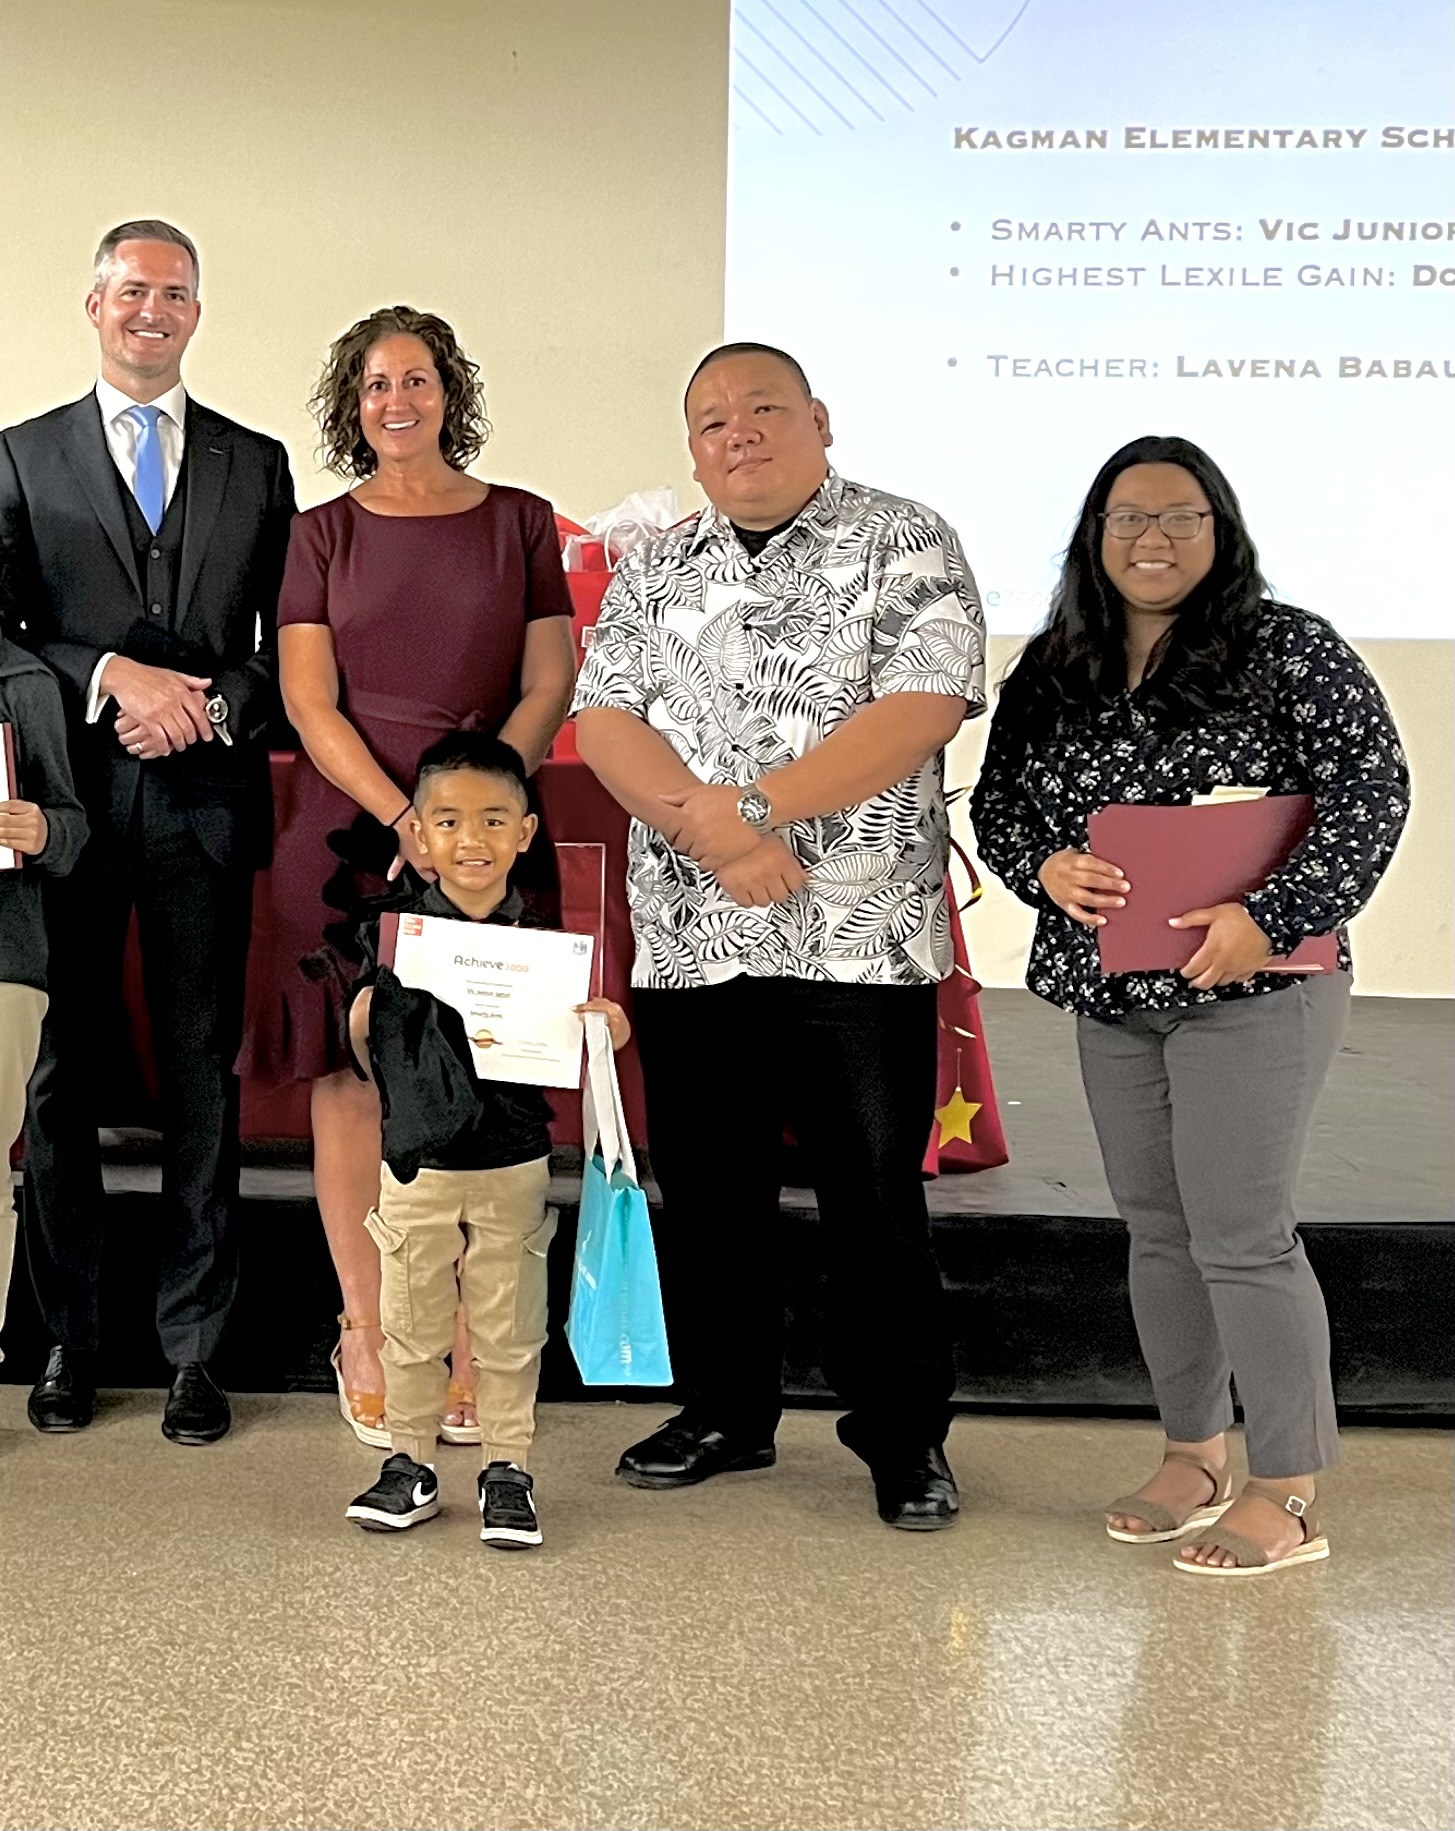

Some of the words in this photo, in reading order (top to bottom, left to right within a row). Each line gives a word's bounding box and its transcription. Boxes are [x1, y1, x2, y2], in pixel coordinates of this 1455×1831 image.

[954, 126, 1108, 149] KAGMAN
[1124, 126, 1368, 149] ELEMENTARY
[991, 218, 1128, 242] SMARTY
[1140, 218, 1242, 242] ANTS:
[1258, 218, 1320, 242] VIC
[991, 264, 1147, 287] HIGHEST
[1161, 264, 1283, 287] LEXILE
[1297, 264, 1395, 287] GAIN:
[986, 354, 1159, 379] TEACHER:
[1176, 354, 1322, 379] LAVENA
